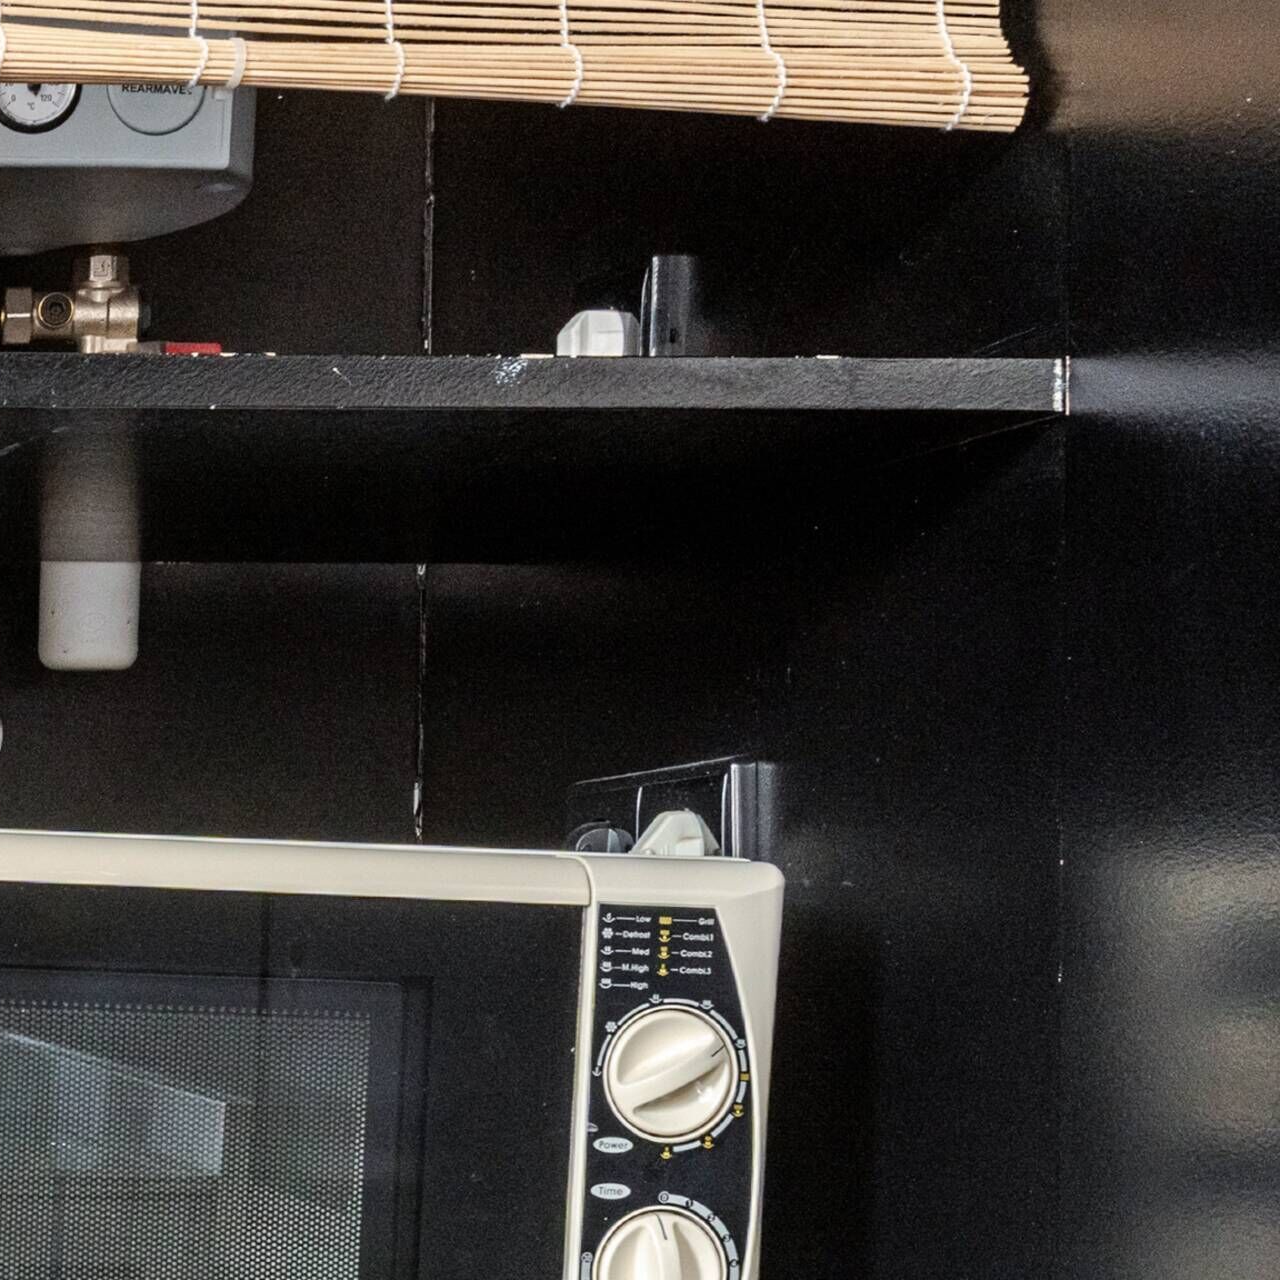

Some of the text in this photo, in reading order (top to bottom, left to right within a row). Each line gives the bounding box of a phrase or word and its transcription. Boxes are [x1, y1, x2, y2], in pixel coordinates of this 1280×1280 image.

[636, 914, 651, 924] Low
[698, 917, 715, 926] Grill
[632, 948, 650, 956] Med
[630, 981, 648, 990] High
[598, 1140, 629, 1150] Power
[598, 1186, 623, 1196] Time
